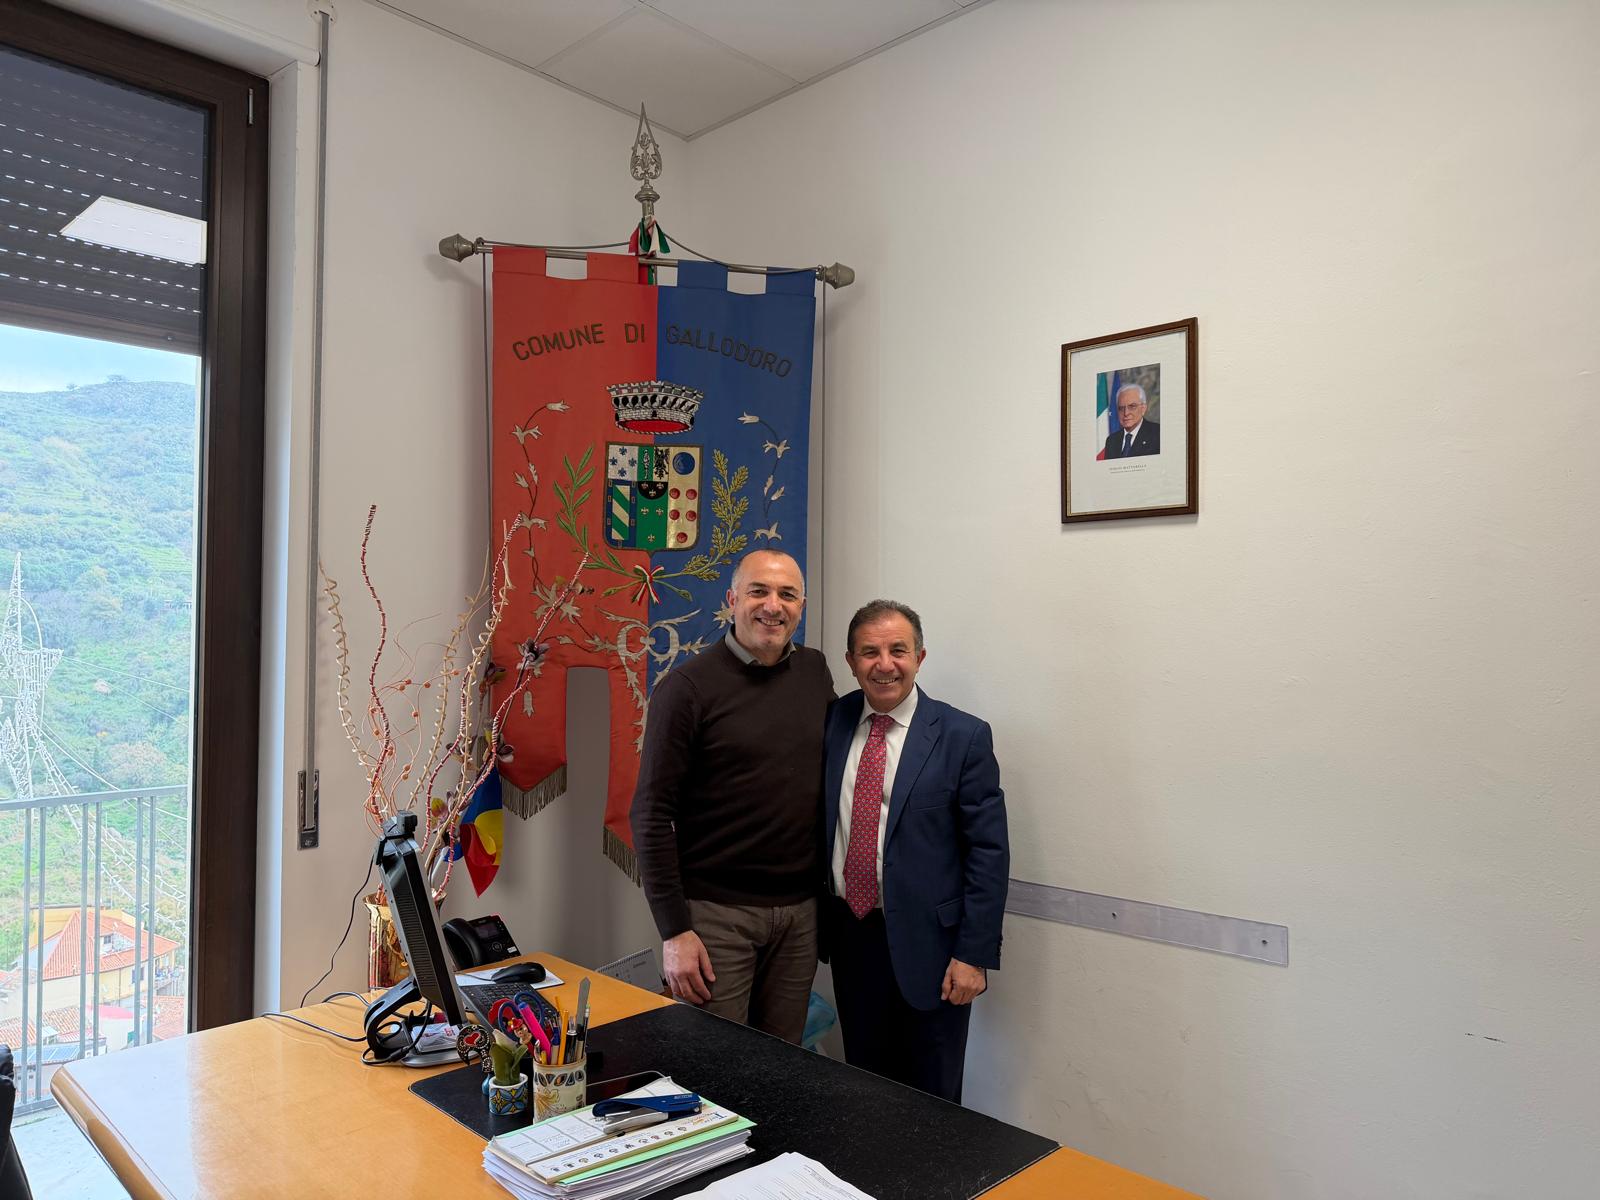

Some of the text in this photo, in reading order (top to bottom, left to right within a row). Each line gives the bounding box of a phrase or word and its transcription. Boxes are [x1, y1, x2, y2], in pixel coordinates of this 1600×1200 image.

[512, 322, 793, 378] COMUNE DI GALLODORO
